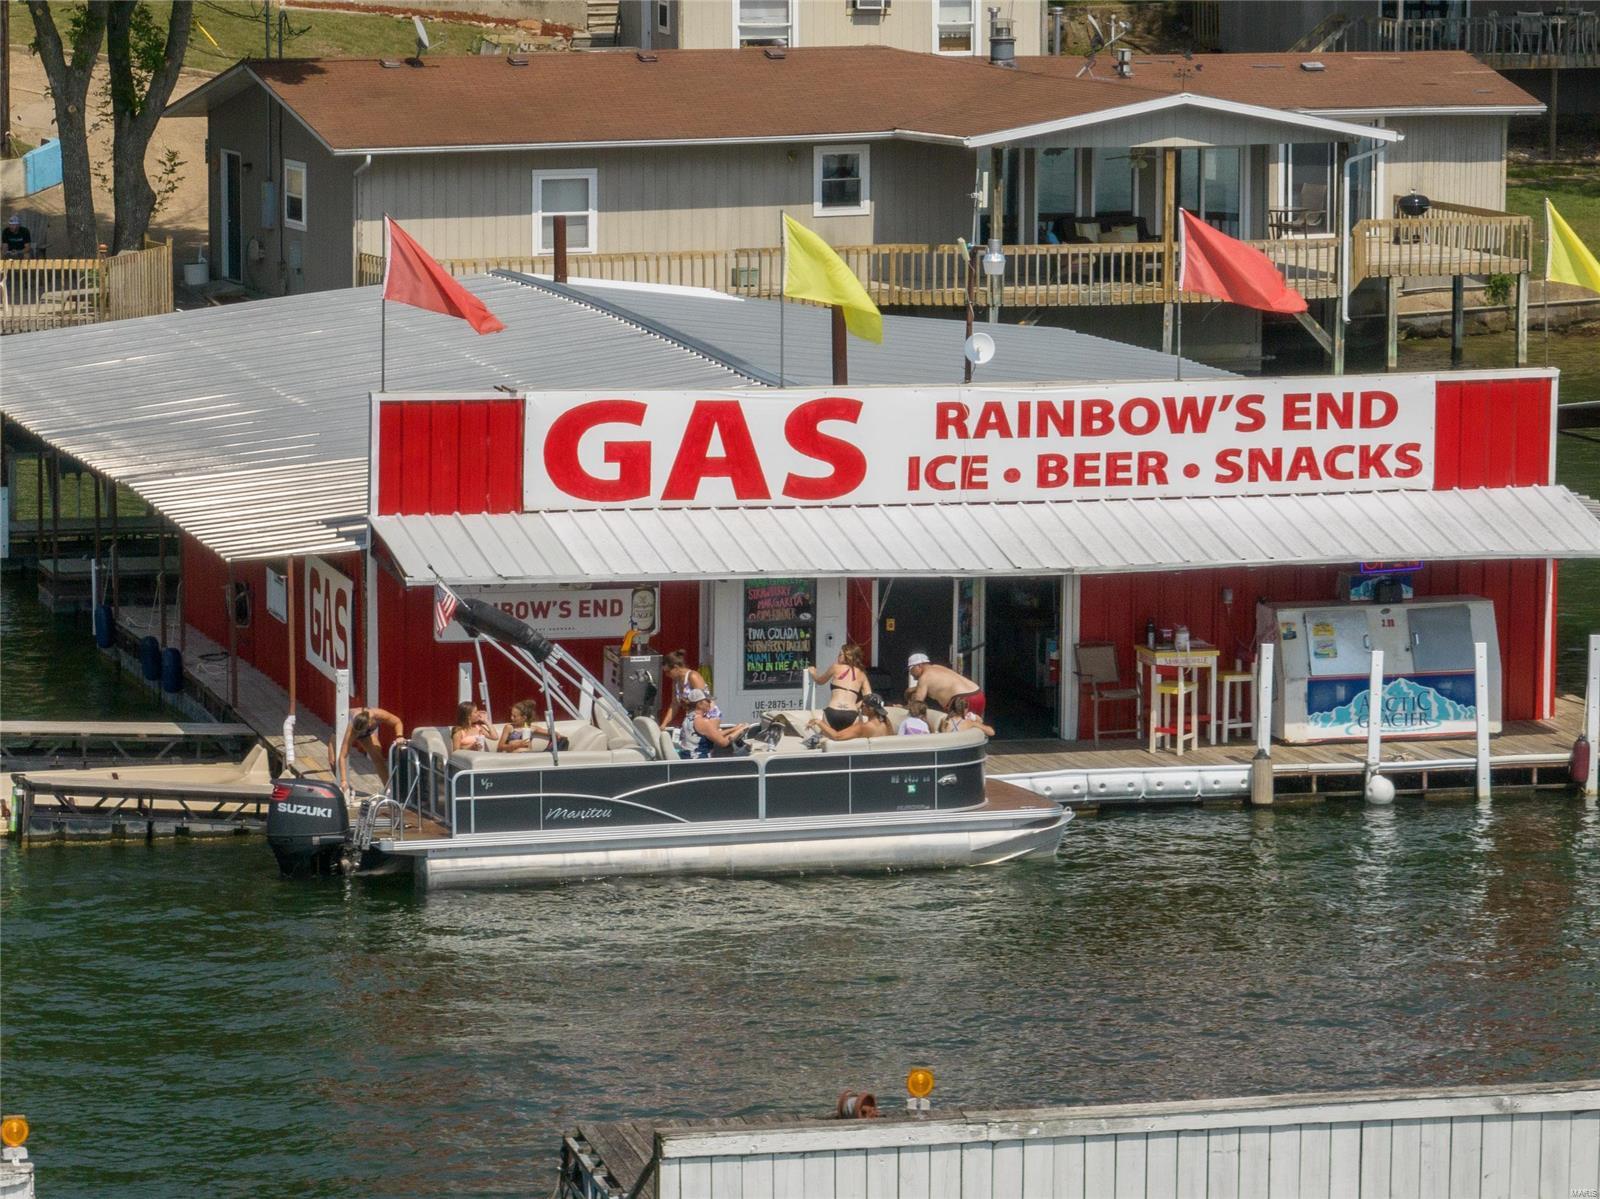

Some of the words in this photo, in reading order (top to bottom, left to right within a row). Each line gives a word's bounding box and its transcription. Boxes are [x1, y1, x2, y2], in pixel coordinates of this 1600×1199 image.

[936, 394, 1266, 439] RAINBOW'S
[1282, 391, 1399, 431] END
[543, 398, 867, 502] GAS
[907, 455, 989, 491] ICE
[1037, 451, 1169, 489] BEER
[1215, 442, 1423, 483] SNACKS
[579, 599, 623, 617] END
[310, 567, 348, 670] GAS
[767, 627, 799, 640] COLADA
[775, 661, 790, 671] THE
[1360, 691, 1429, 713] ACTIC
[1357, 712, 1429, 729] GACIER
[277, 802, 332, 818] SUZUKI
[545, 807, 612, 820] Manitou
